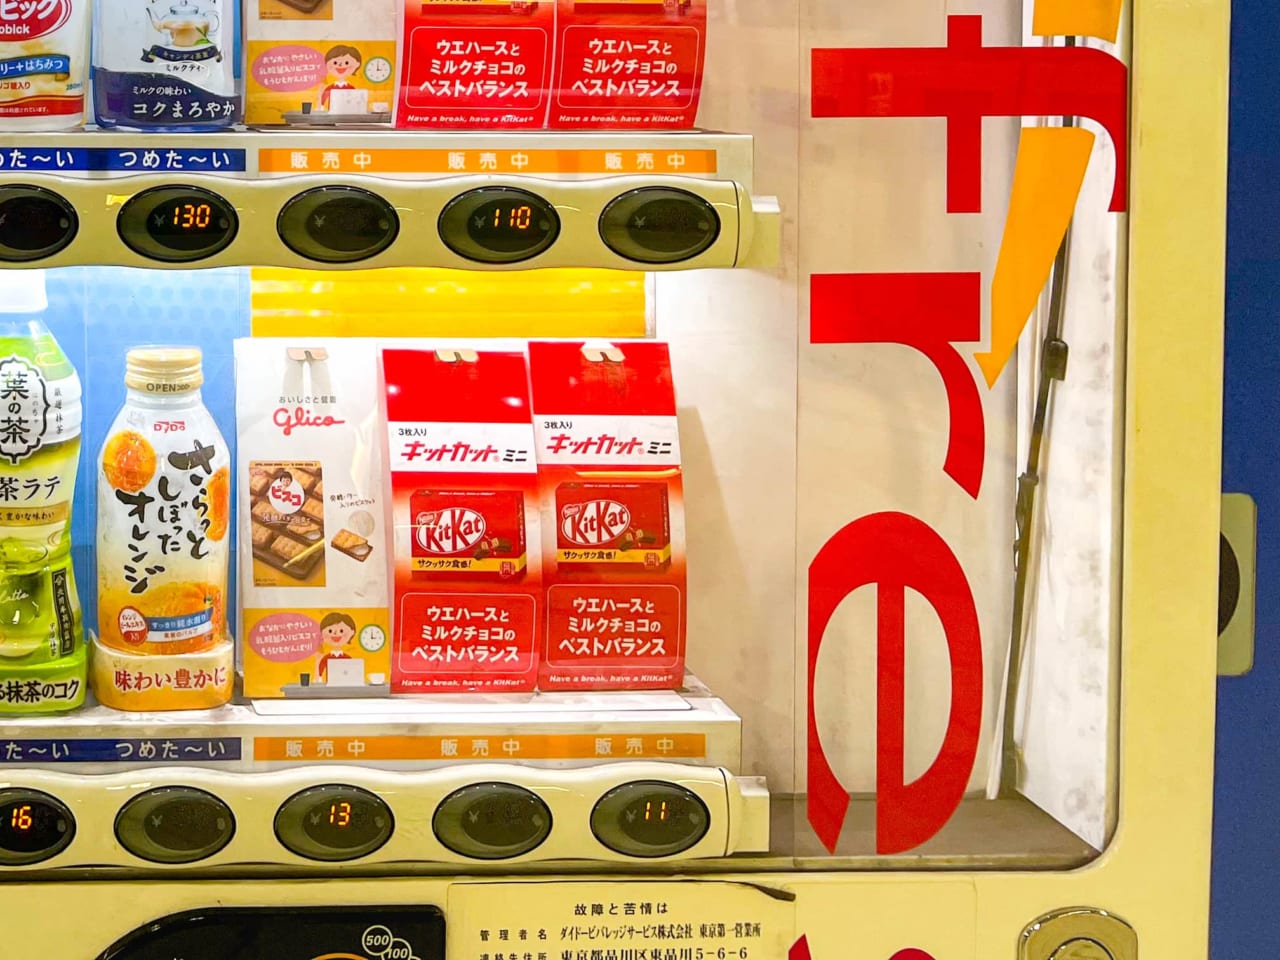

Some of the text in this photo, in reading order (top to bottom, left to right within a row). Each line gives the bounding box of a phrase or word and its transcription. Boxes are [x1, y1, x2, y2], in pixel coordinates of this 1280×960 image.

[436, 39, 520, 56] ウエハースと
[588, 38, 672, 55] ウエハースと
[429, 58, 526, 76] ミルクチョコの
[582, 58, 677, 75] ミルクチョコの
[133, 85, 192, 97] ミルクの味わい
[419, 79, 529, 98] ベストバランス
[571, 79, 680, 98] ベストバランス
[133, 100, 235, 118] コクまろやか
[407, 114, 430, 123] Have
[468, 115, 490, 123] have
[173, 204, 211, 228] 130
[493, 206, 531, 230] 110
[146, 382, 177, 393] OPEN
[502, 449, 528, 463] ミニ
[167, 439, 216, 560] さらっと
[270, 486, 302, 506] ビスコ
[158, 475, 188, 555] しぼった
[115, 488, 165, 594] オレンジ
[426, 606, 510, 624] ウエハースと
[421, 623, 516, 642] ミルクチョコの
[411, 646, 520, 664] ベストバランス
[114, 667, 226, 690] 味わい豊かに
[574, 902, 668, 916] 故障と苦情は
[366, 934, 389, 946] 500
[480, 929, 548, 940] 管理者名
[700, 922, 761, 939] 東京第一営業所
